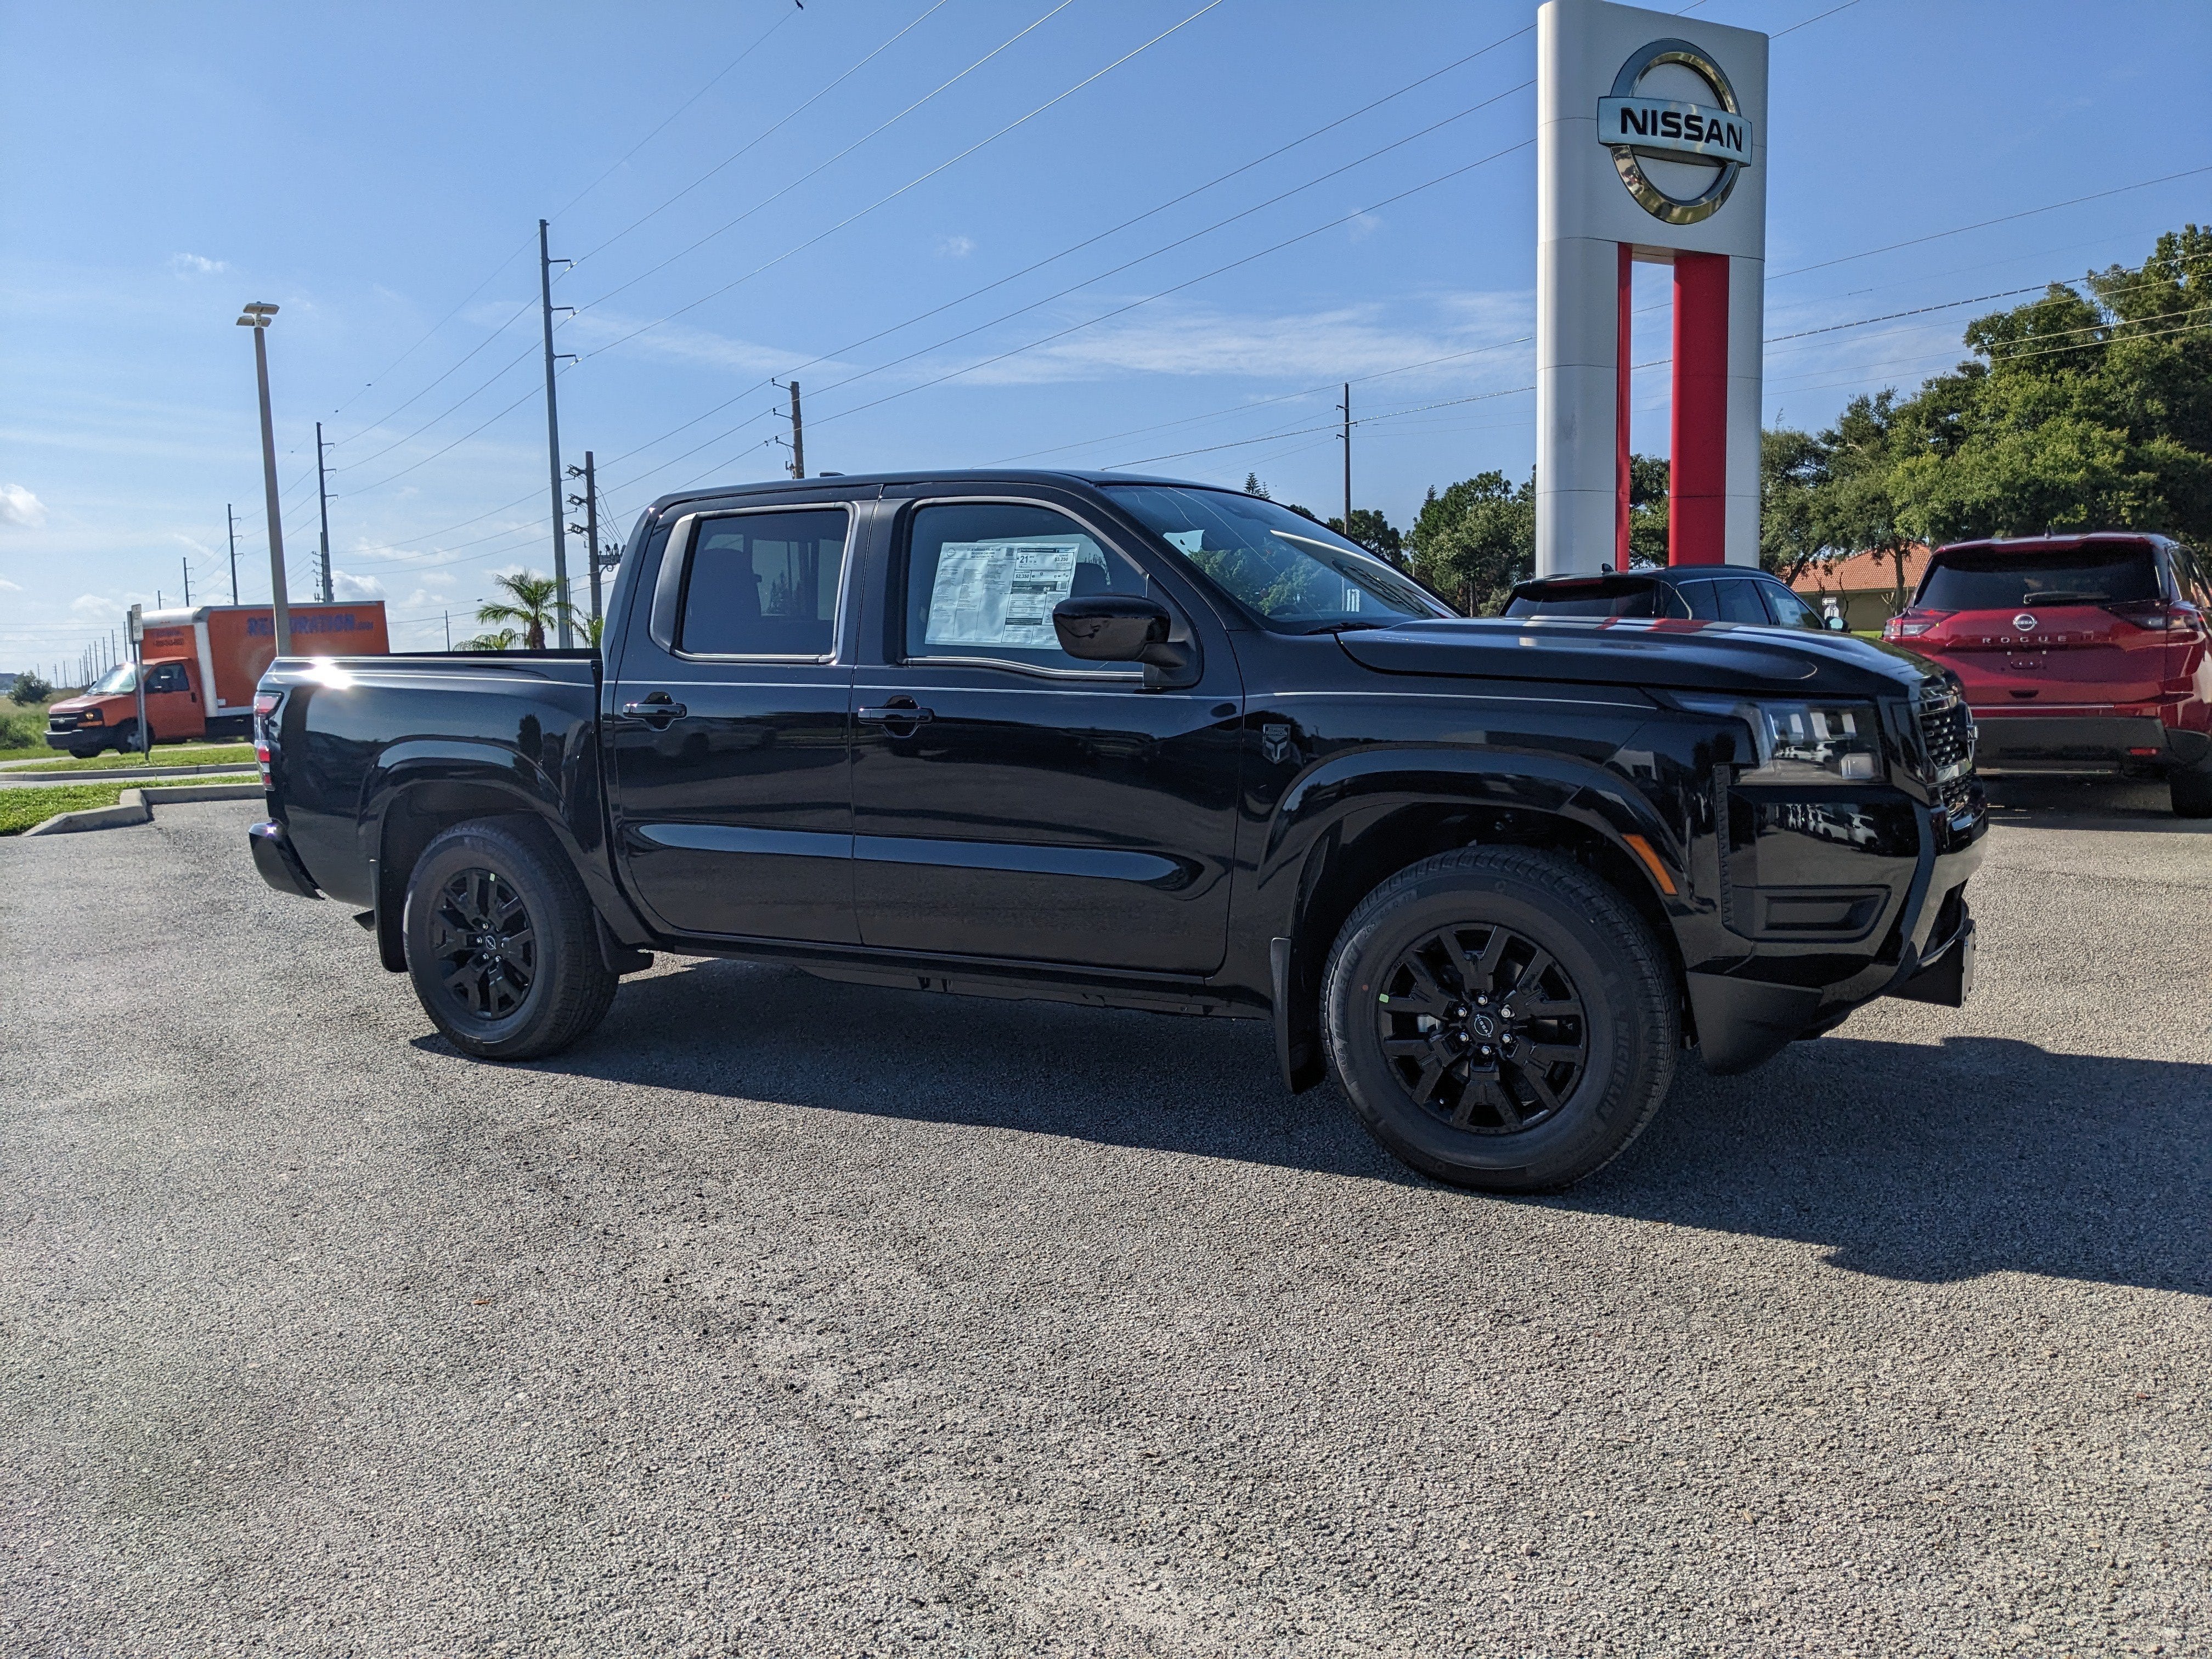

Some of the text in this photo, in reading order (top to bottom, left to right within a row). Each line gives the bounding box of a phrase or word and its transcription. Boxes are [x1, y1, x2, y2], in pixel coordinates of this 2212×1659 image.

[1621, 108, 1742, 153] NISSAN
[1982, 635, 2067, 644] ROGUE
[1476, 1014, 1491, 1037] NISSAN
